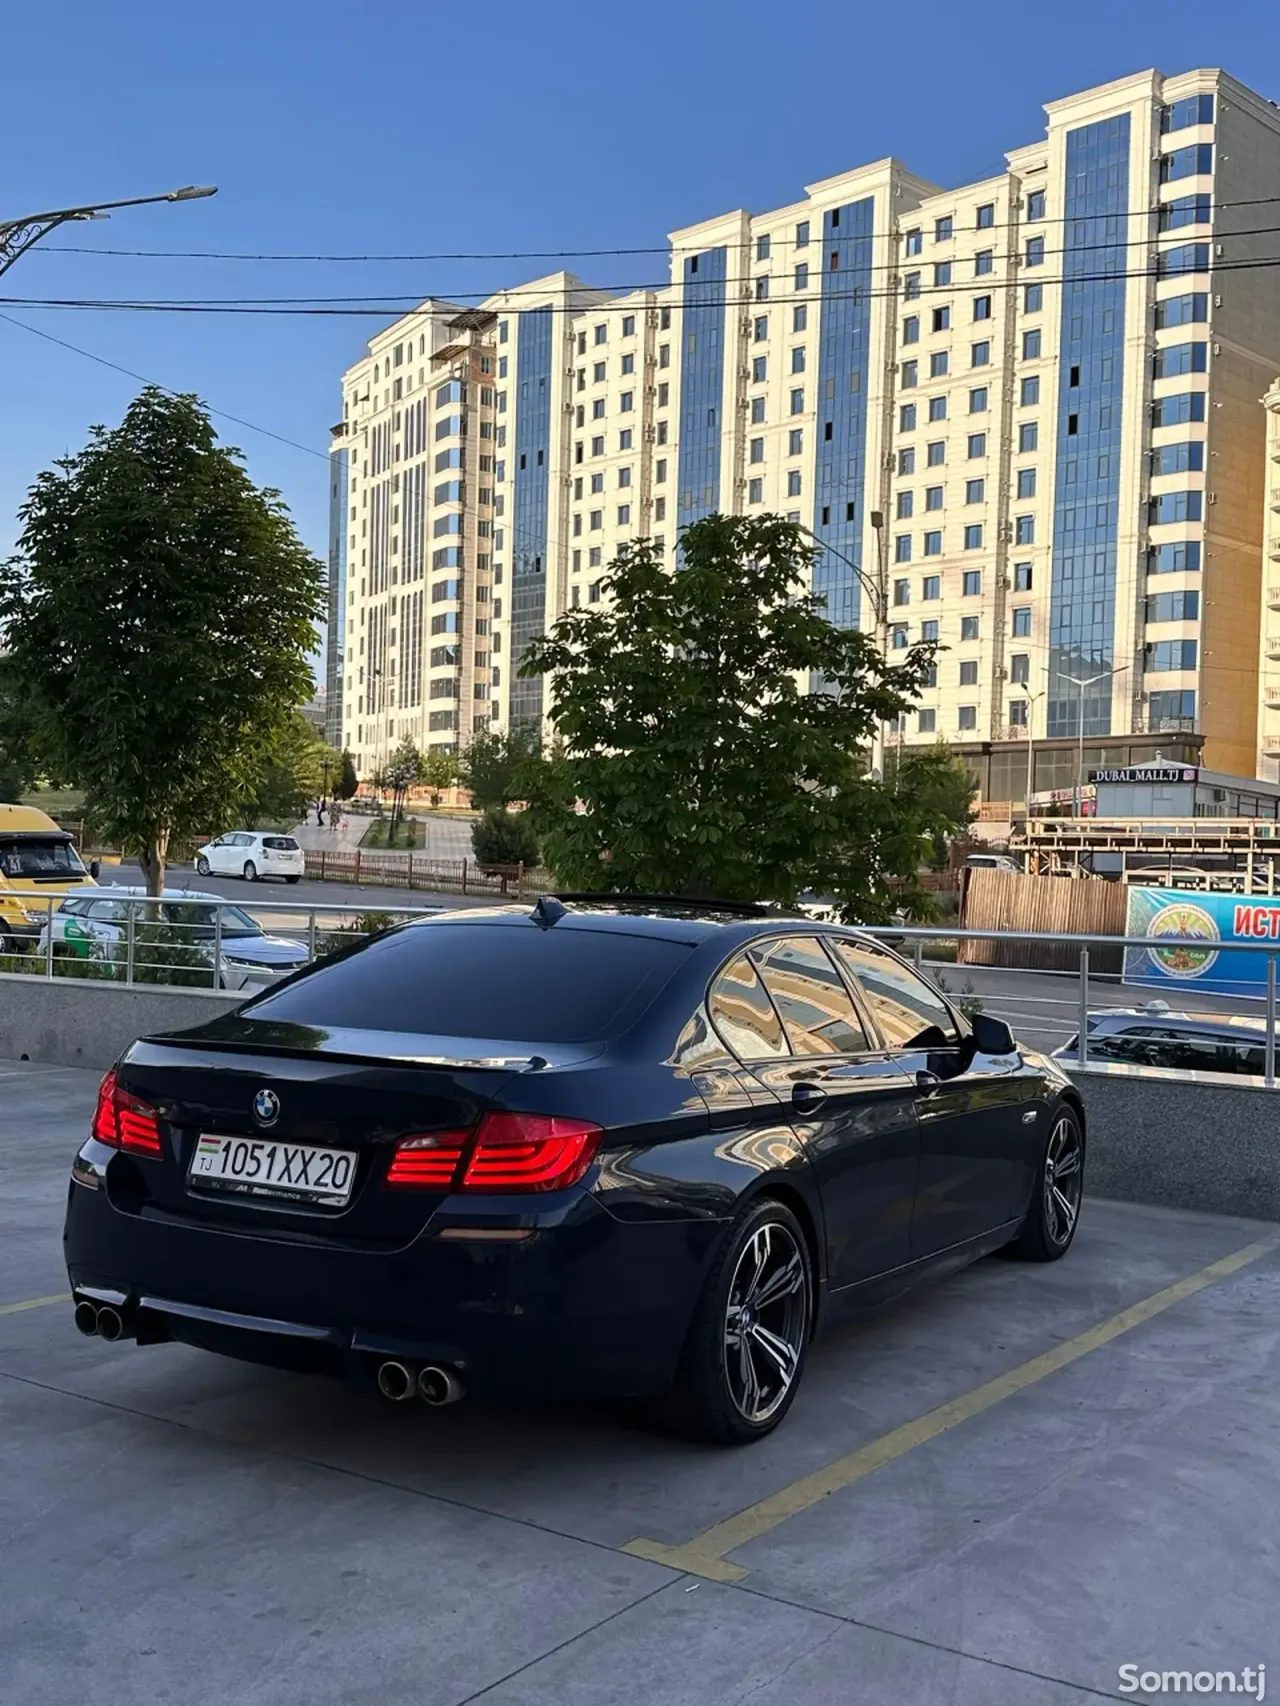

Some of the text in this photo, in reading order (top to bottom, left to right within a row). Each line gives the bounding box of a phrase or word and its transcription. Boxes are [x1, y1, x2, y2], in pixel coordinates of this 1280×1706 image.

[1235, 905, 1280, 938] ИСТ
[199, 1157, 213, 1171] TJ
[221, 1140, 351, 1189] 1051XX20
